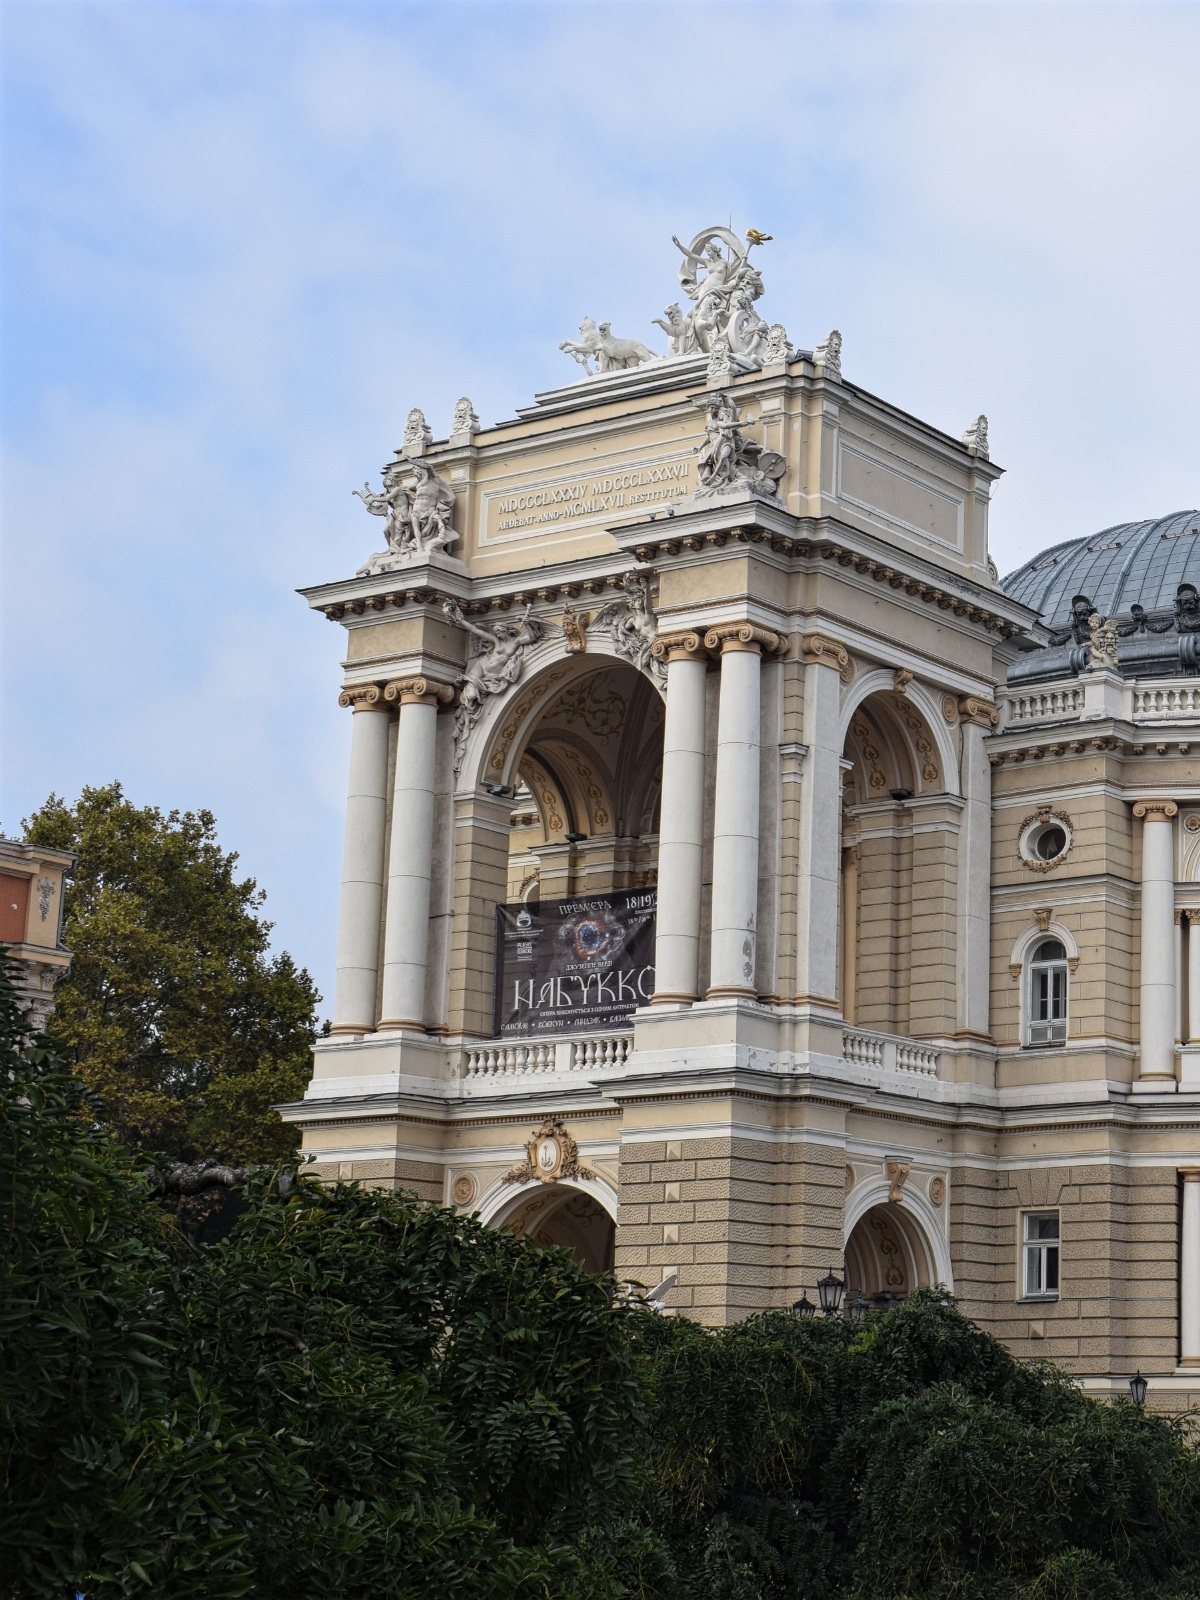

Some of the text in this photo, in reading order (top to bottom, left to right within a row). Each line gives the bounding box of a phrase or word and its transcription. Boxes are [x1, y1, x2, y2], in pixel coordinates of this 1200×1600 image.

[498, 463, 689, 515] MDCCCLXXXIV MDCCCLXXXVII
[629, 485, 687, 505] RESTITUTUM
[559, 900, 612, 915] ПРЕМ'ЄРА
[514, 965, 656, 1010] НАБУККО
